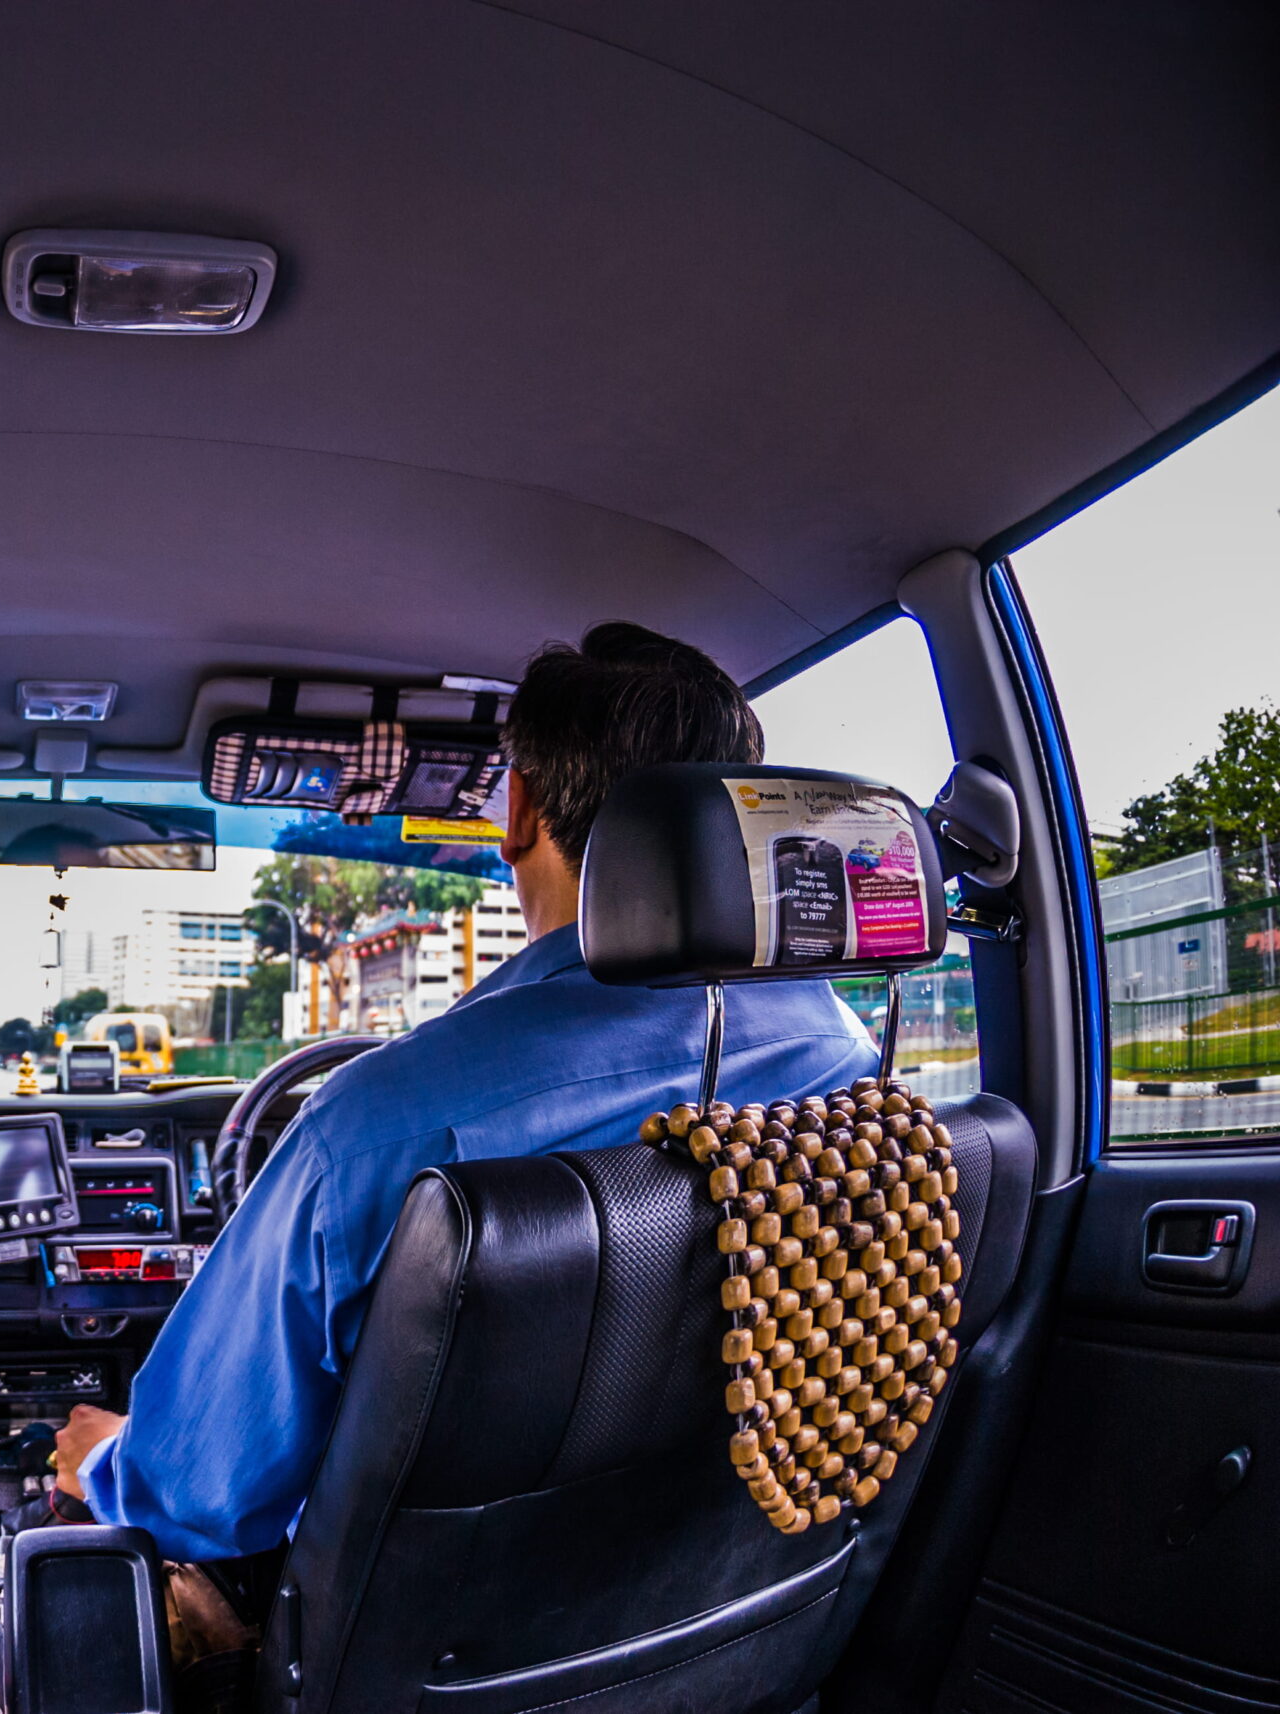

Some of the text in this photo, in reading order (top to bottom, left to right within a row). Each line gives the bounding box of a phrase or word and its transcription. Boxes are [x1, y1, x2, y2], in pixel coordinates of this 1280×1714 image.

[738, 791, 787, 801] LinkPoints
[794, 867, 802, 875] To
[795, 880, 828, 890] simply sms
[785, 888, 800, 897] LOM
[800, 911, 807, 919] to
